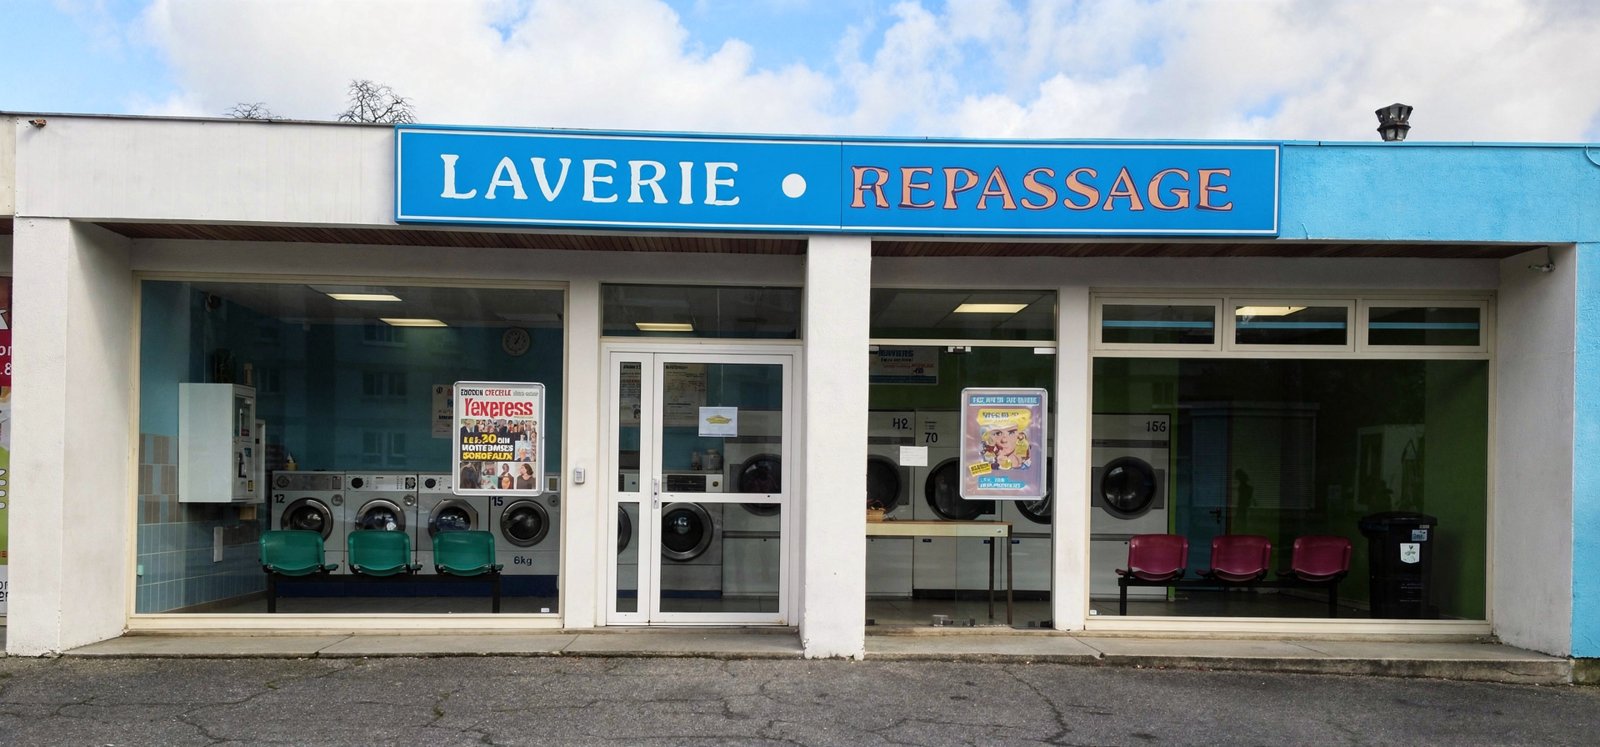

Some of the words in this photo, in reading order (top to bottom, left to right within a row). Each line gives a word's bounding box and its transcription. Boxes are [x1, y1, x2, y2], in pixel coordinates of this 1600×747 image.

[439, 153, 740, 206] LAVERIE
[850, 165, 1233, 211] REPASSAGE
[924, 432, 938, 443] 70
[274, 493, 285, 504] 12
[492, 496, 503, 506] 15
